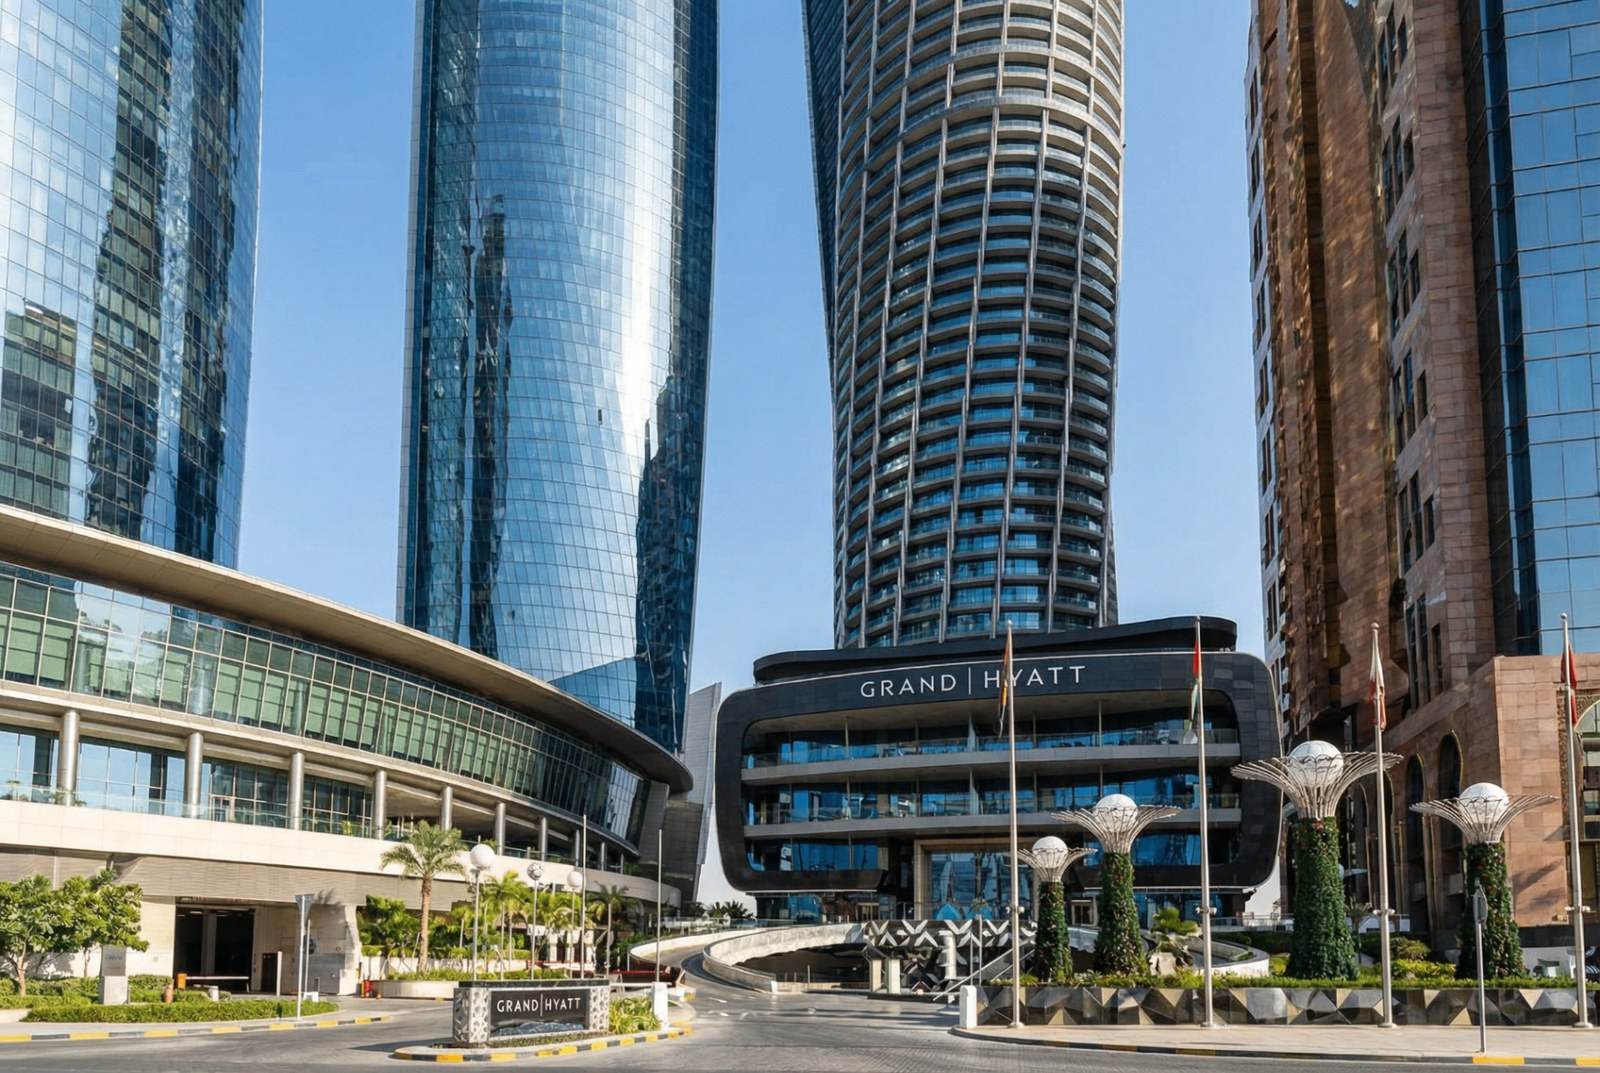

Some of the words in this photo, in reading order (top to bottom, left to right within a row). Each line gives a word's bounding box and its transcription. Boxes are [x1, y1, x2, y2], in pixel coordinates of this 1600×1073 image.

[860, 674, 957, 698] GRAND
[984, 665, 1086, 689] HYATT
[496, 999, 539, 1013] GRAND
[544, 997, 581, 1011] HYATT
